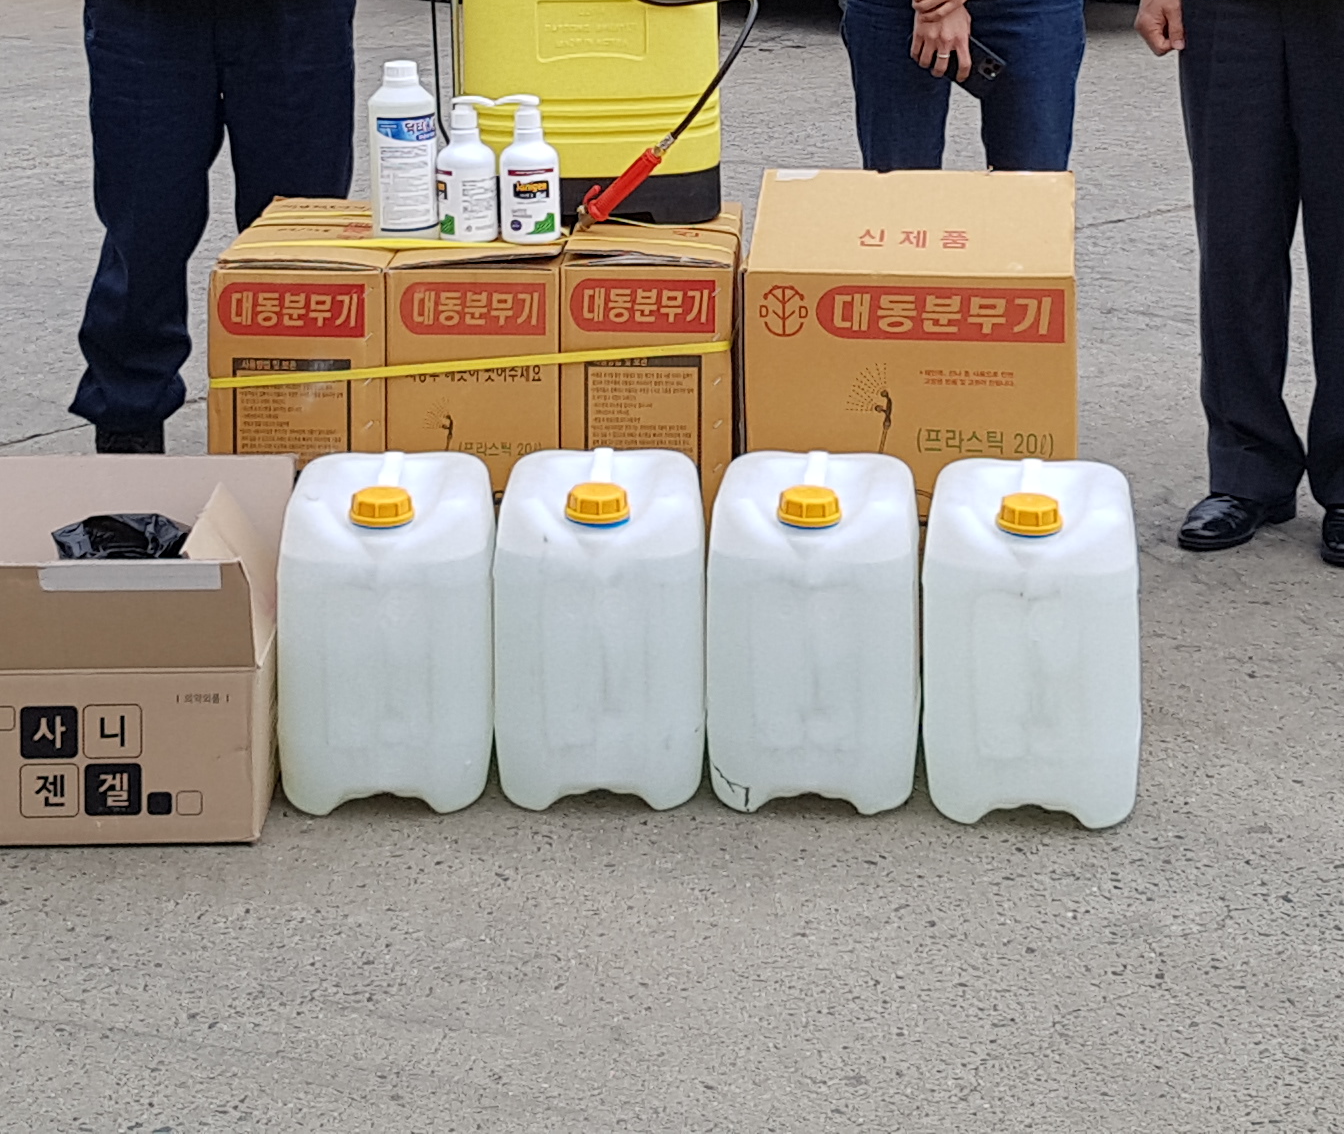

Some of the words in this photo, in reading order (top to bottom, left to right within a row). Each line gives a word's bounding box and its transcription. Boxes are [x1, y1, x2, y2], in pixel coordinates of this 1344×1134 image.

[858, 229, 969, 249] 신제품
[230, 290, 358, 328] 대동분무기
[412, 290, 539, 326] 대동분무기
[582, 287, 709, 323] 대동분무기
[833, 292, 1053, 335] 대동분무기
[916, 428, 1004, 454] (프라스틱
